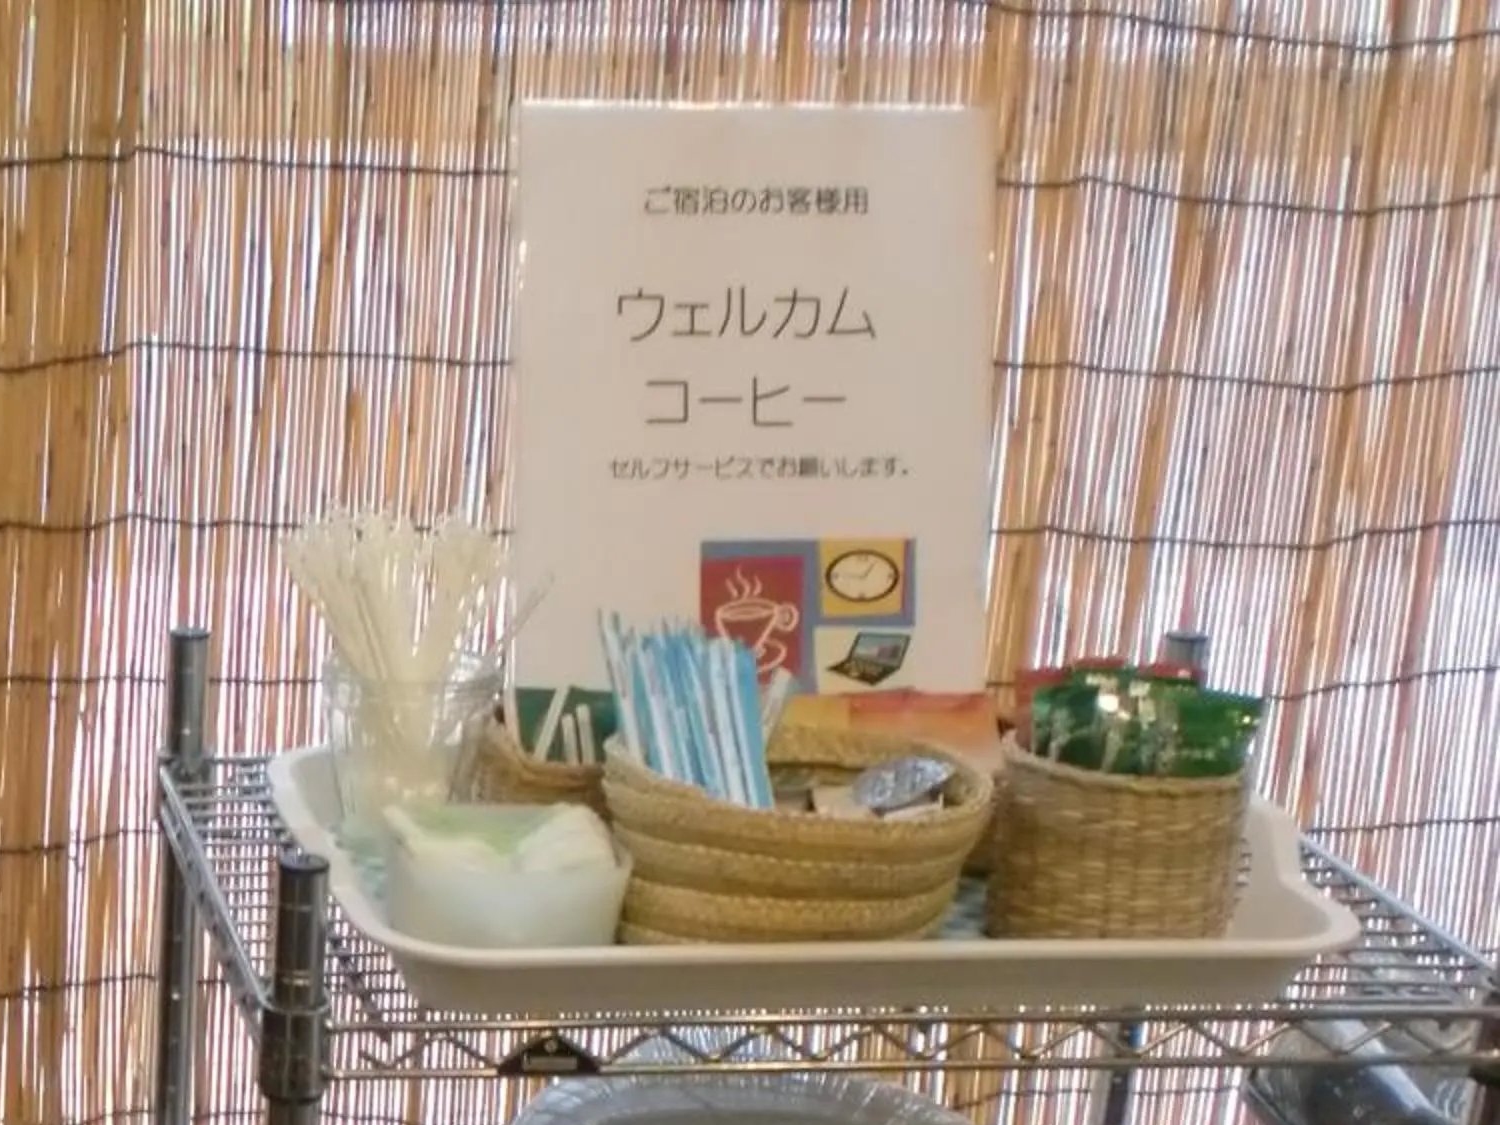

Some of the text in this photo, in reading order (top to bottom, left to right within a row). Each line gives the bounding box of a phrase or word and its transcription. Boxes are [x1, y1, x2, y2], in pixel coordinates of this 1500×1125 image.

[643, 185, 870, 216] ご宿泊のお客様用
[616, 285, 877, 342] ウェルカム
[644, 375, 848, 429] コーヒー
